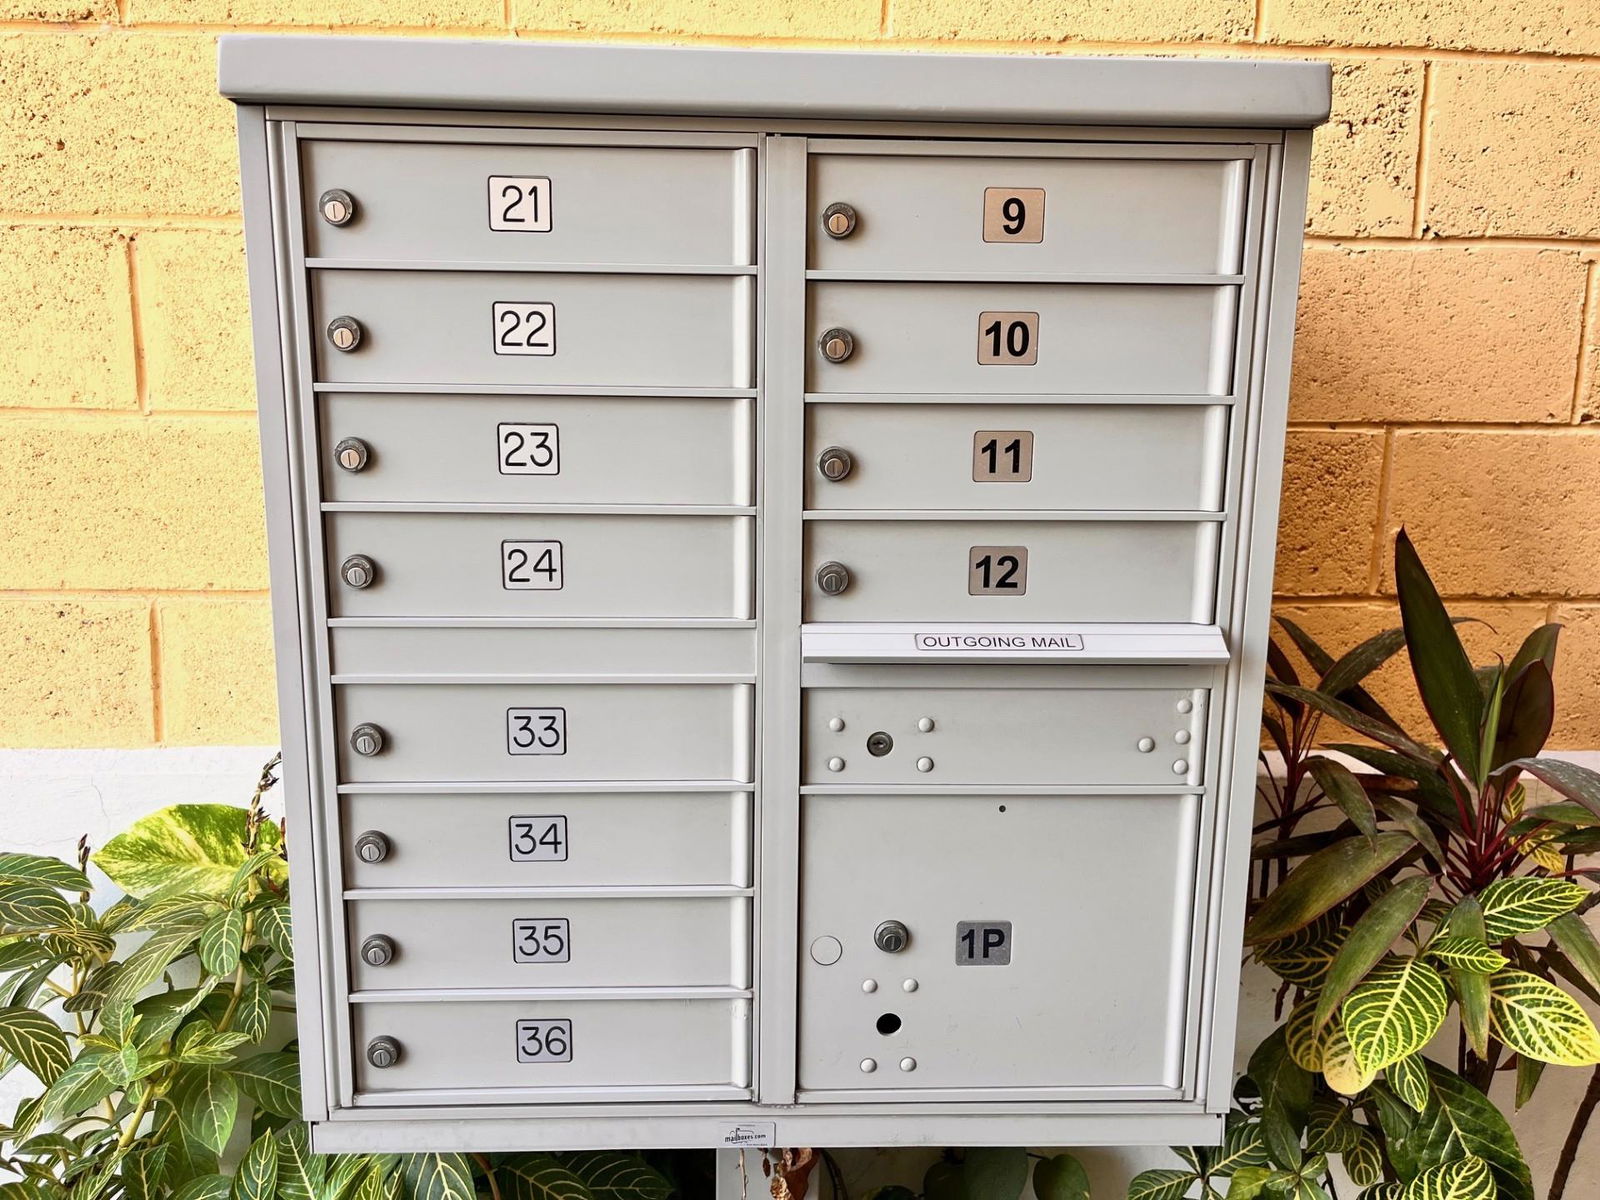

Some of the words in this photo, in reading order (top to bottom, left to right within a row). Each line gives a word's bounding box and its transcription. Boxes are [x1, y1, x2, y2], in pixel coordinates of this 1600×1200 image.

[502, 185, 538, 222] 21
[1003, 198, 1025, 234] 9
[501, 311, 548, 347] 22
[986, 321, 1029, 357] 10
[505, 432, 553, 467] 23
[982, 439, 1020, 473] 11
[508, 549, 556, 582] 24
[976, 556, 1018, 588] 12
[923, 637, 1025, 647] OUTGOING
[1032, 638, 1076, 647] MAIL
[514, 716, 559, 747] 33
[515, 823, 560, 854] 34
[519, 926, 563, 956] 35
[962, 929, 1005, 958] 1P
[522, 1026, 566, 1056] 36
